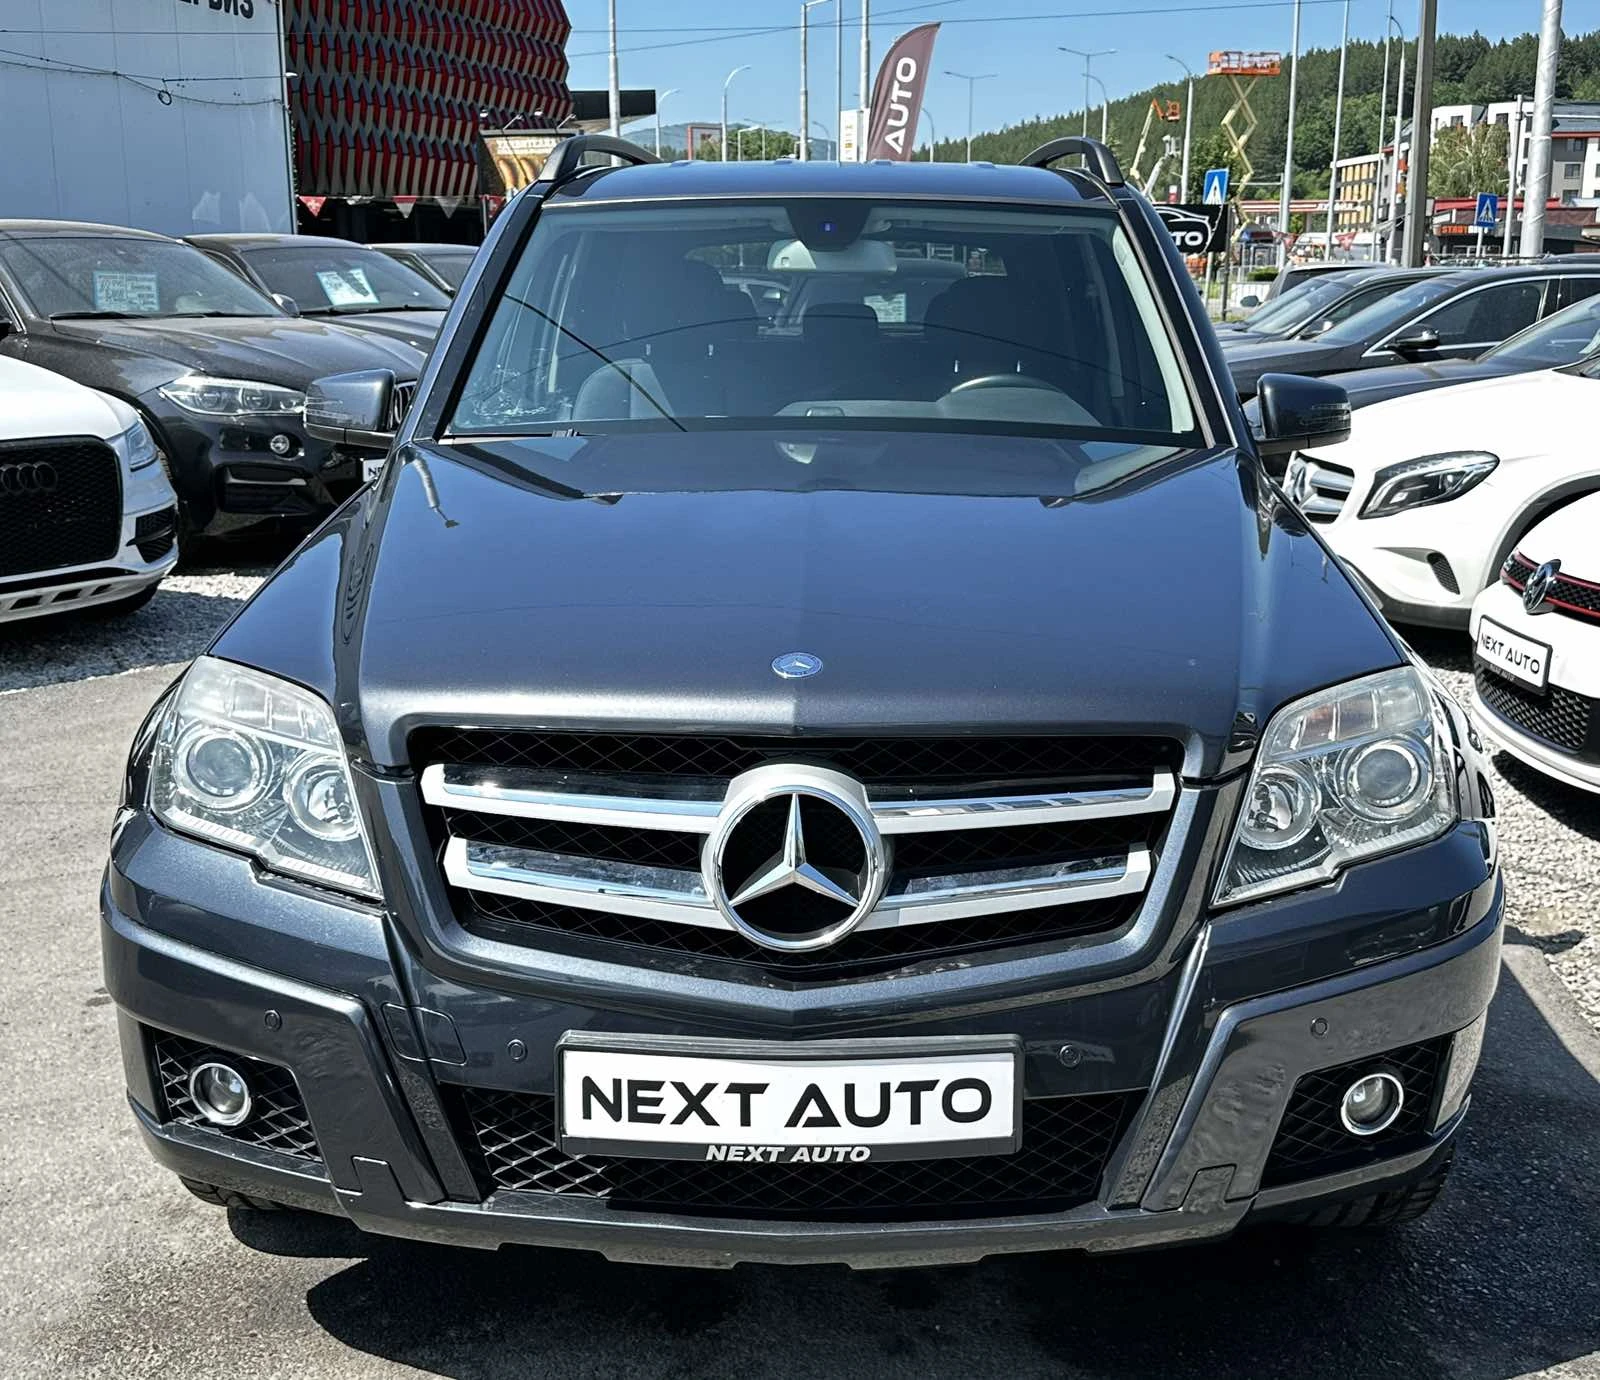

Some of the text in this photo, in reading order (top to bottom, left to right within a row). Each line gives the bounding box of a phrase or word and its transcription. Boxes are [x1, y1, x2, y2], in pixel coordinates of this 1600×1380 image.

[884, 56, 917, 155] AUTO
[1169, 231, 1203, 246] TO
[1481, 632, 1505, 657] NEXT
[1505, 647, 1540, 675] AUTO
[582, 1075, 993, 1129] NEXT AUTO
[705, 1145, 871, 1163] NEXT AUTO
